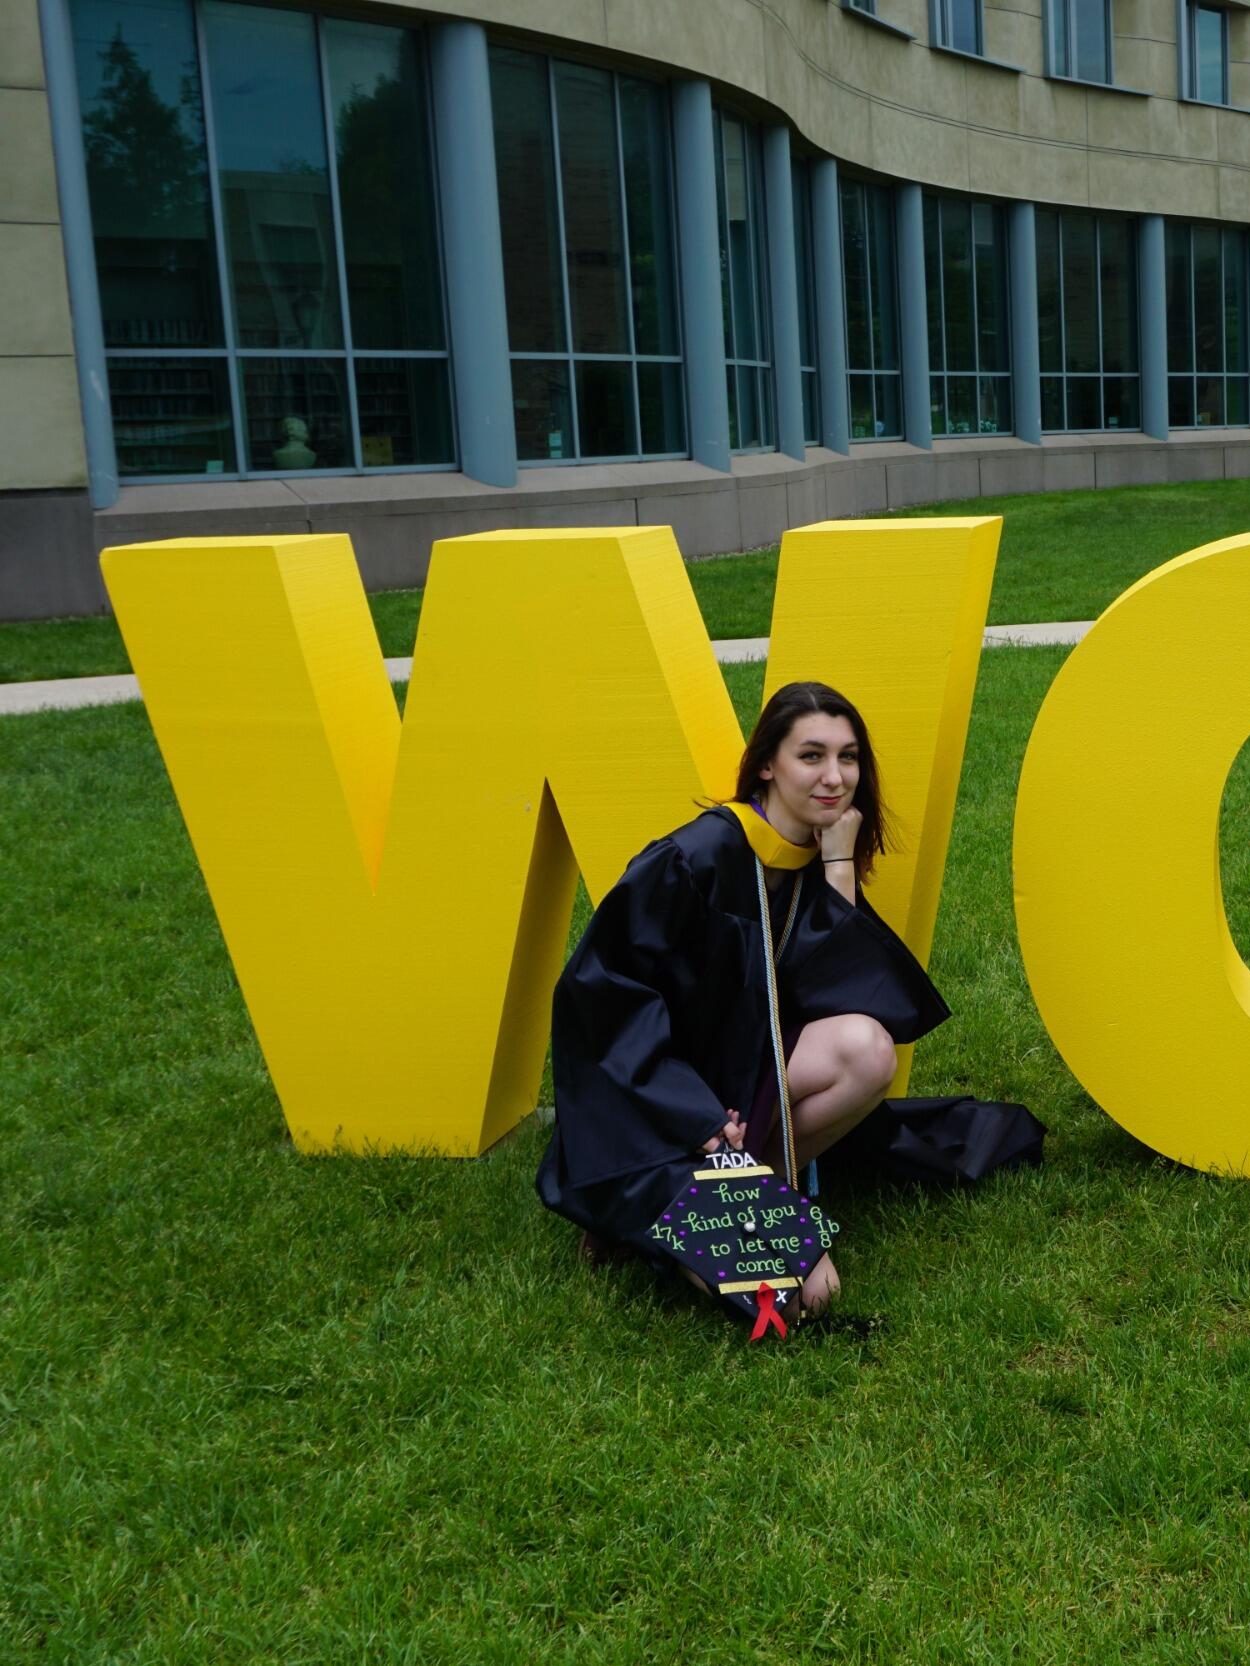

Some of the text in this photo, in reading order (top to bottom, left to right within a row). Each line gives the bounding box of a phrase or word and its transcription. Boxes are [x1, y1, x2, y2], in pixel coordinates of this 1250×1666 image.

[705, 1151, 758, 1169] TADA
[711, 1182, 760, 1203] how
[681, 1205, 797, 1233] kind of you
[710, 1235, 800, 1258] to let me
[736, 1257, 786, 1275] come
